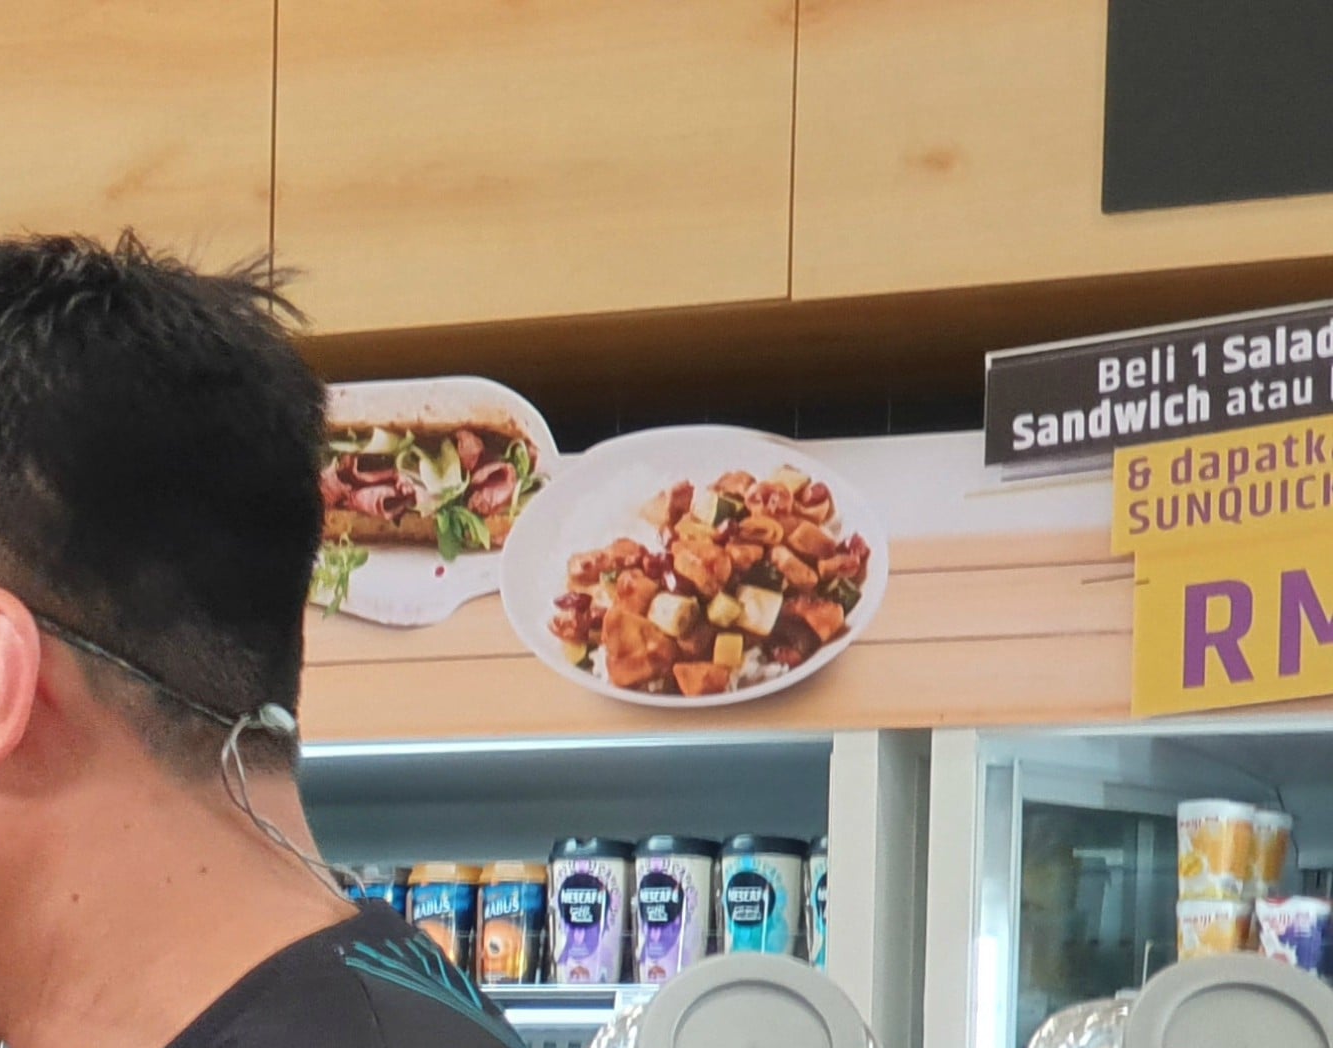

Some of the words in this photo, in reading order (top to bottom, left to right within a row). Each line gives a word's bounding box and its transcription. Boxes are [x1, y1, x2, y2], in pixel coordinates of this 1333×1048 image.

[1097, 345, 1176, 394] Beli
[1191, 341, 1208, 378] 1
[1222, 321, 1333, 375] Salad
[1011, 384, 1211, 451] Sandwich
[1225, 375, 1314, 417] atau
[1127, 455, 1152, 493] &
[1169, 427, 1333, 497] dapatk
[1181, 567, 1333, 690] RM
